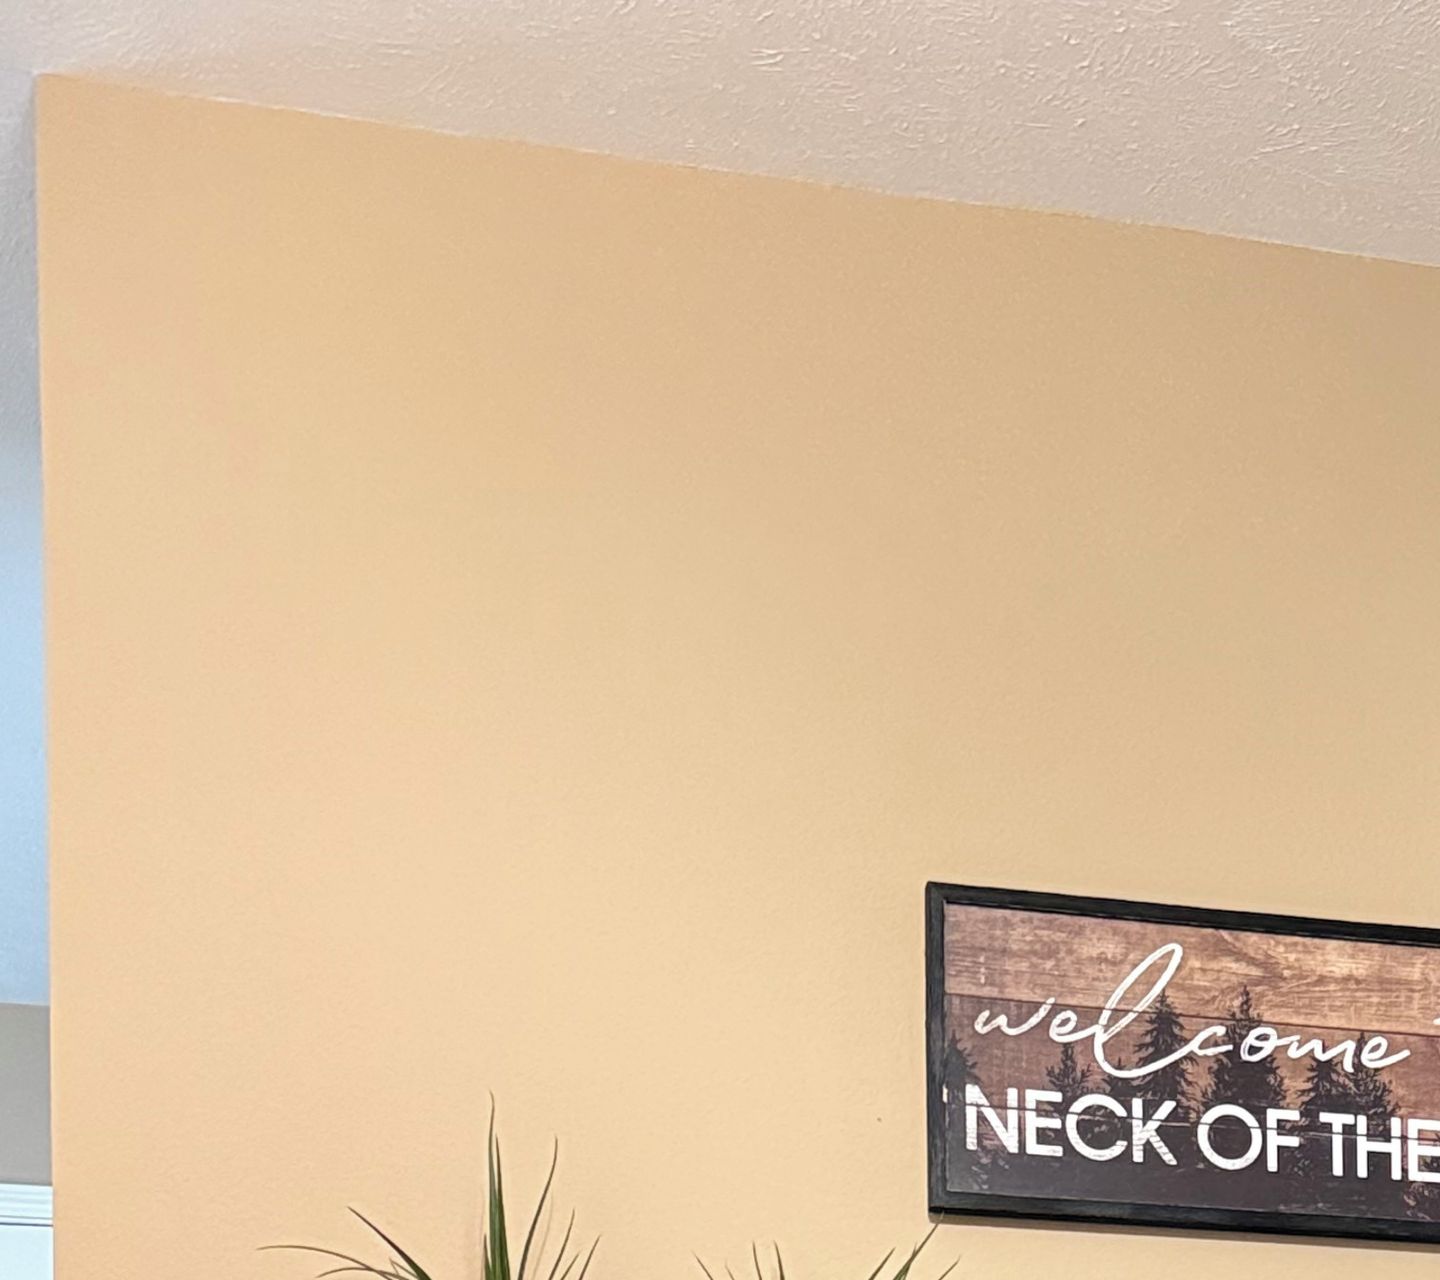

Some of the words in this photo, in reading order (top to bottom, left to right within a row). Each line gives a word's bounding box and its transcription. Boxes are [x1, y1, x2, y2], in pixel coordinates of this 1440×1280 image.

[973, 942, 1412, 1078] welcome
[965, 1083, 1178, 1166] NECK
[1197, 1104, 1302, 1172] OF
